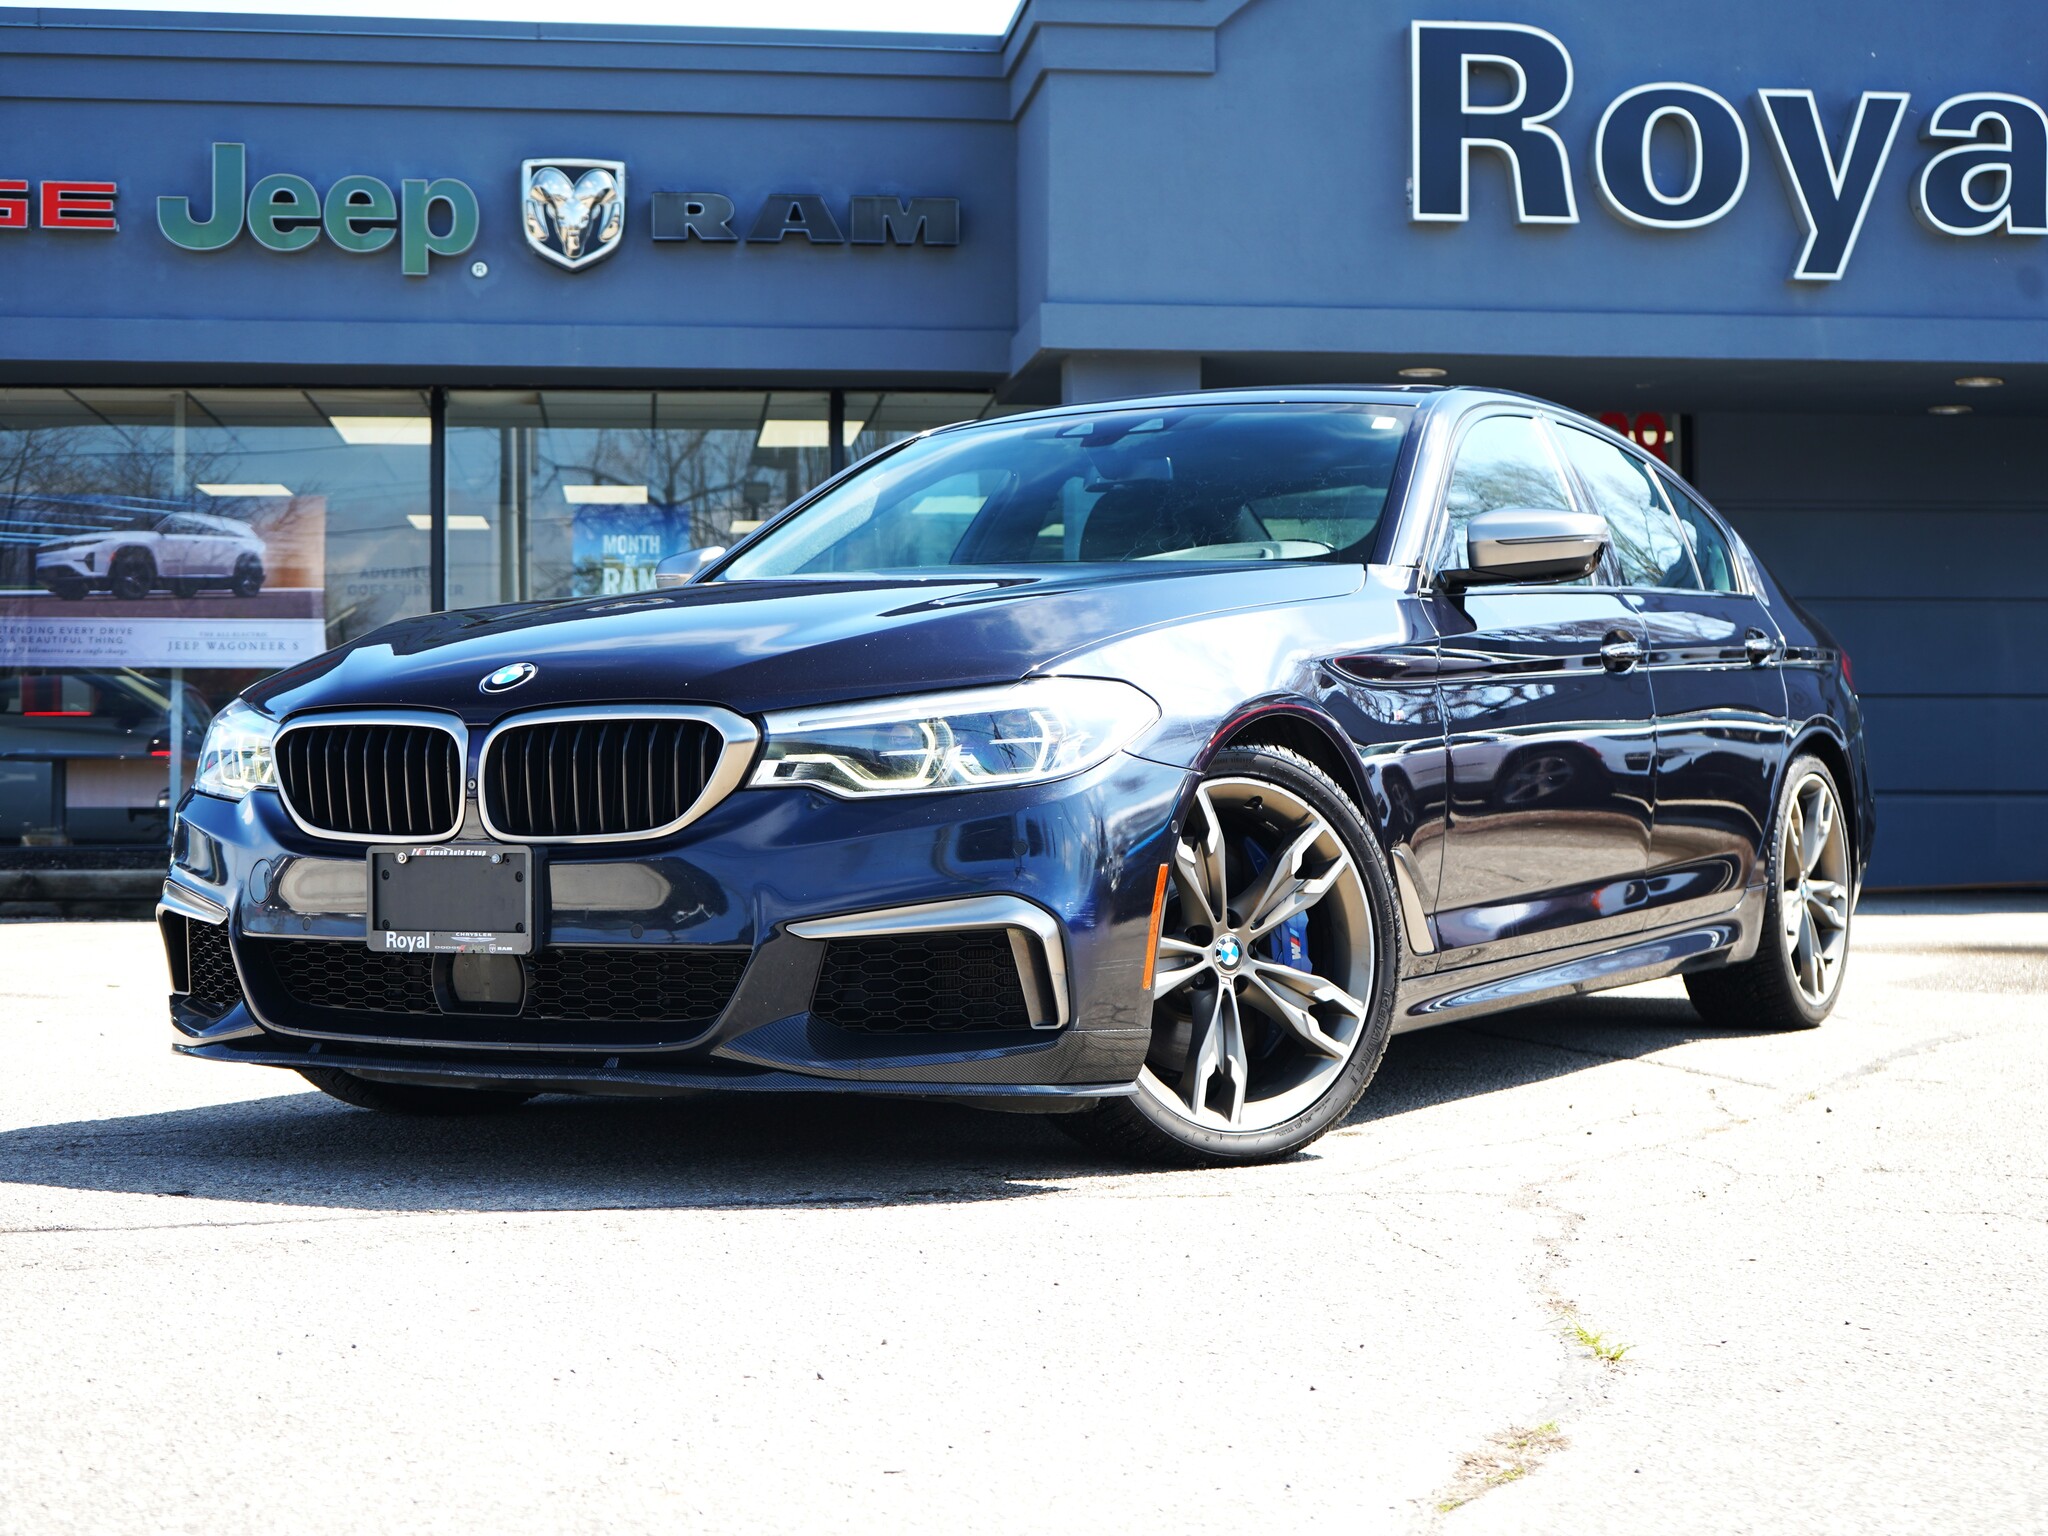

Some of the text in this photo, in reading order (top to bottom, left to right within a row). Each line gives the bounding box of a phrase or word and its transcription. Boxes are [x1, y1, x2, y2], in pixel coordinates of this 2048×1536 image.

[1411, 20, 2048, 280] Roya
[157, 142, 480, 276] Jeep
[651, 192, 960, 246] RAM
[603, 535, 660, 555] MONTH
[603, 568, 657, 595] RAM
[21, 635, 83, 644] BEAUTIFUL
[59, 626, 95, 635] EVERY
[100, 626, 133, 635] DRIVE
[167, 641, 300, 652] JEEP WAGONEER S
[466, 849, 487, 857] Group
[385, 931, 430, 952] Royal
